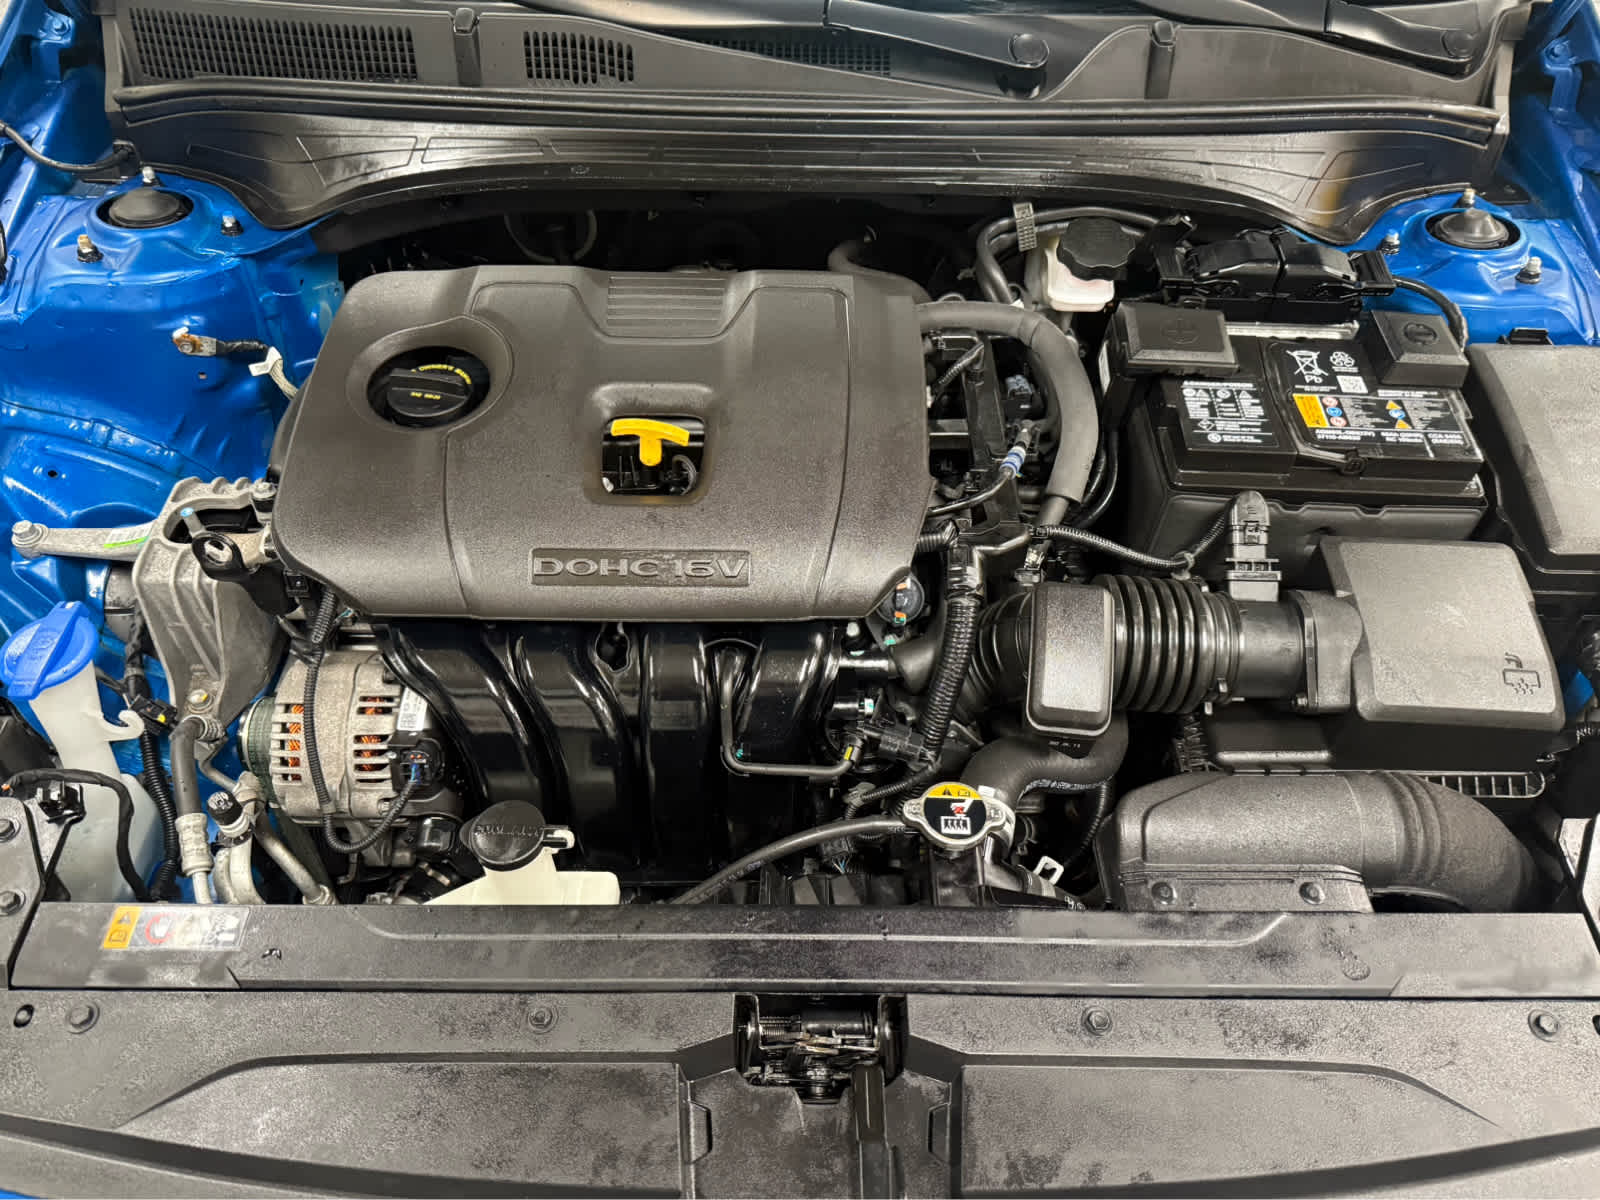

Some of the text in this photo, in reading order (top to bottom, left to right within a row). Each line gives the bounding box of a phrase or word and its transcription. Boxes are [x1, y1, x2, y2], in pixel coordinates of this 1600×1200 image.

[1304, 375, 1323, 384] Pb
[533, 557, 747, 577] DOHC 16V
